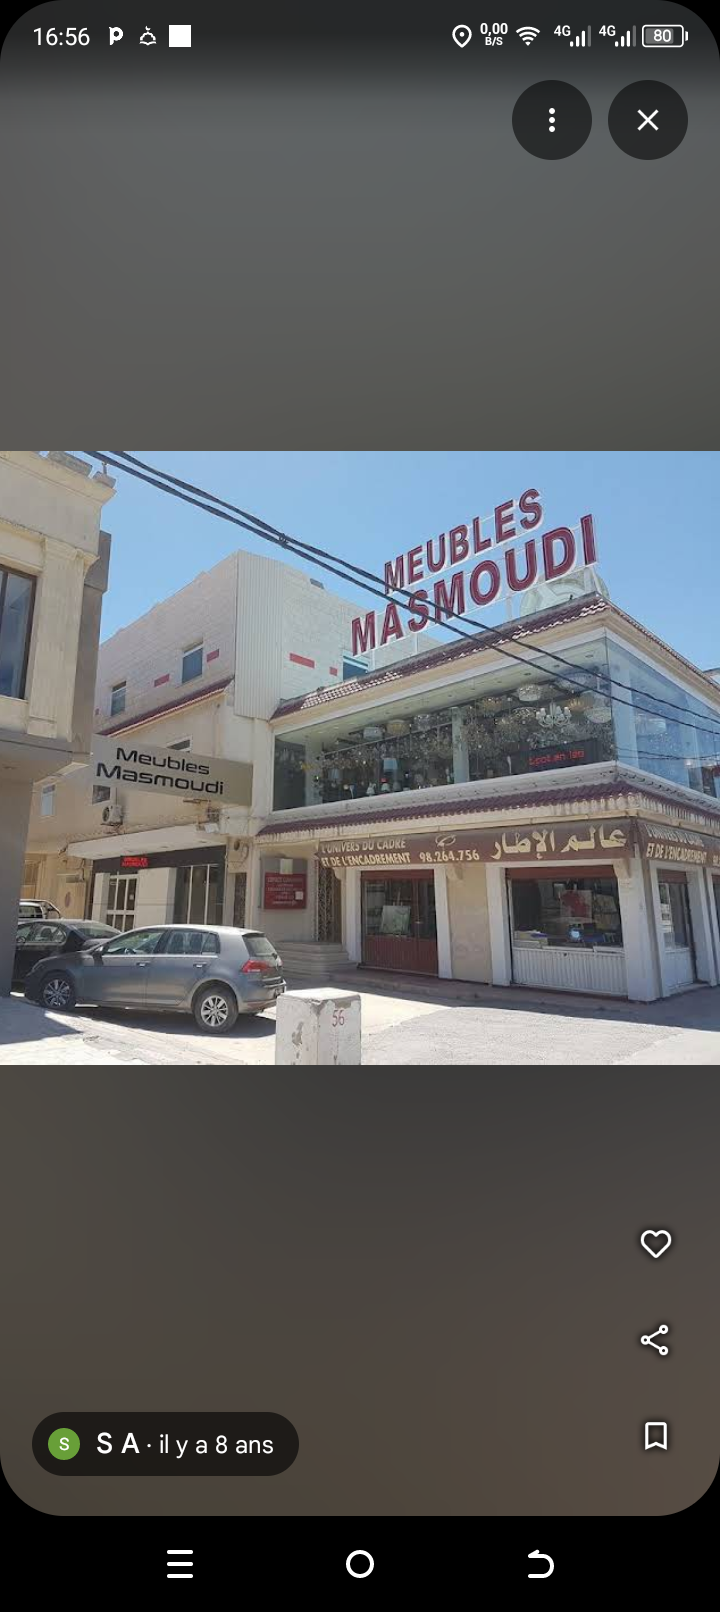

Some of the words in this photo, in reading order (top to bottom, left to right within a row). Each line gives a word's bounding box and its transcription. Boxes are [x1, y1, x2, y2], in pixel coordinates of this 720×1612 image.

[384, 488, 543, 596] MEUBLES
[351, 513, 598, 657] MASMOUDI
[116, 747, 210, 775] Meubles
[96, 762, 224, 795] Masmoudi
[362, 841, 375, 851] DU
[377, 839, 406, 850] CADRE
[490, 829, 556, 860] الإطار
[560, 824, 627, 853] عالم
[321, 857, 330, 867] ET
[330, 856, 342, 867] DE
[342, 852, 411, 866] L'ENCADREMENT
[419, 849, 480, 863] 98.264.756
[332, 1009, 345, 1027] 56
